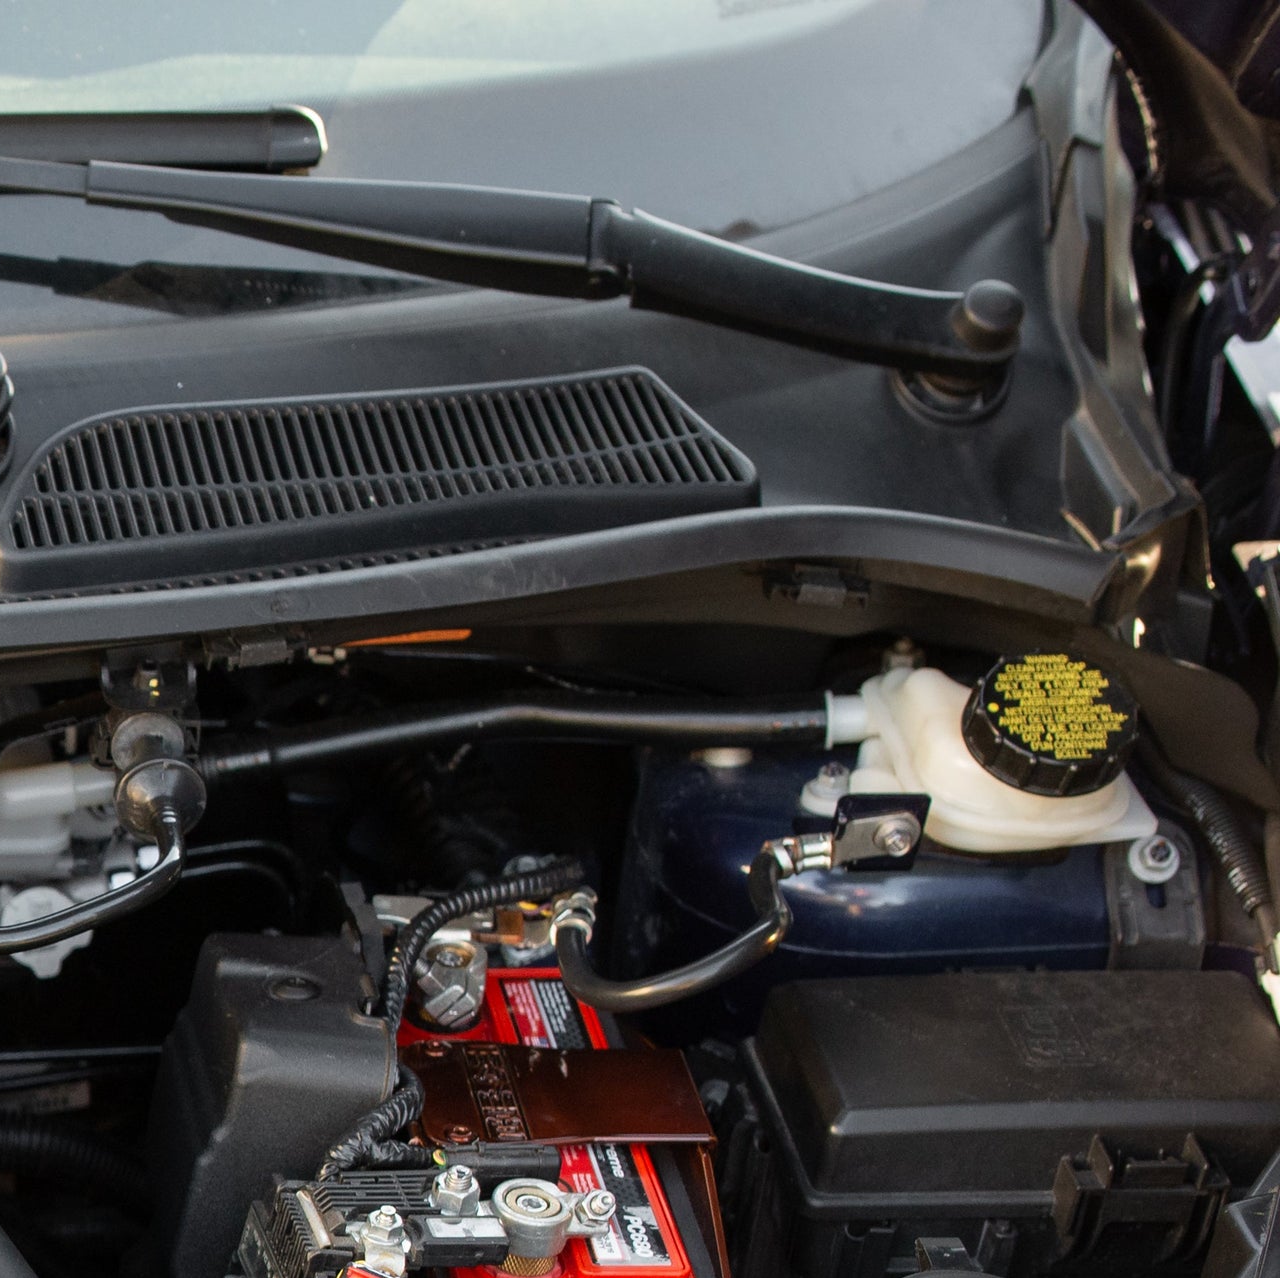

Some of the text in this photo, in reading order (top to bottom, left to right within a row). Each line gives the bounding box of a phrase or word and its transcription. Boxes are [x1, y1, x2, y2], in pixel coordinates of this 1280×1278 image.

[1066, 661, 1087, 671] CAP
[994, 681, 1018, 692] ONLY
[1021, 680, 1040, 690] DOT
[1082, 678, 1109, 689] FROM
[1021, 732, 1040, 742] DOT
[622, 1214, 654, 1258] PC680
